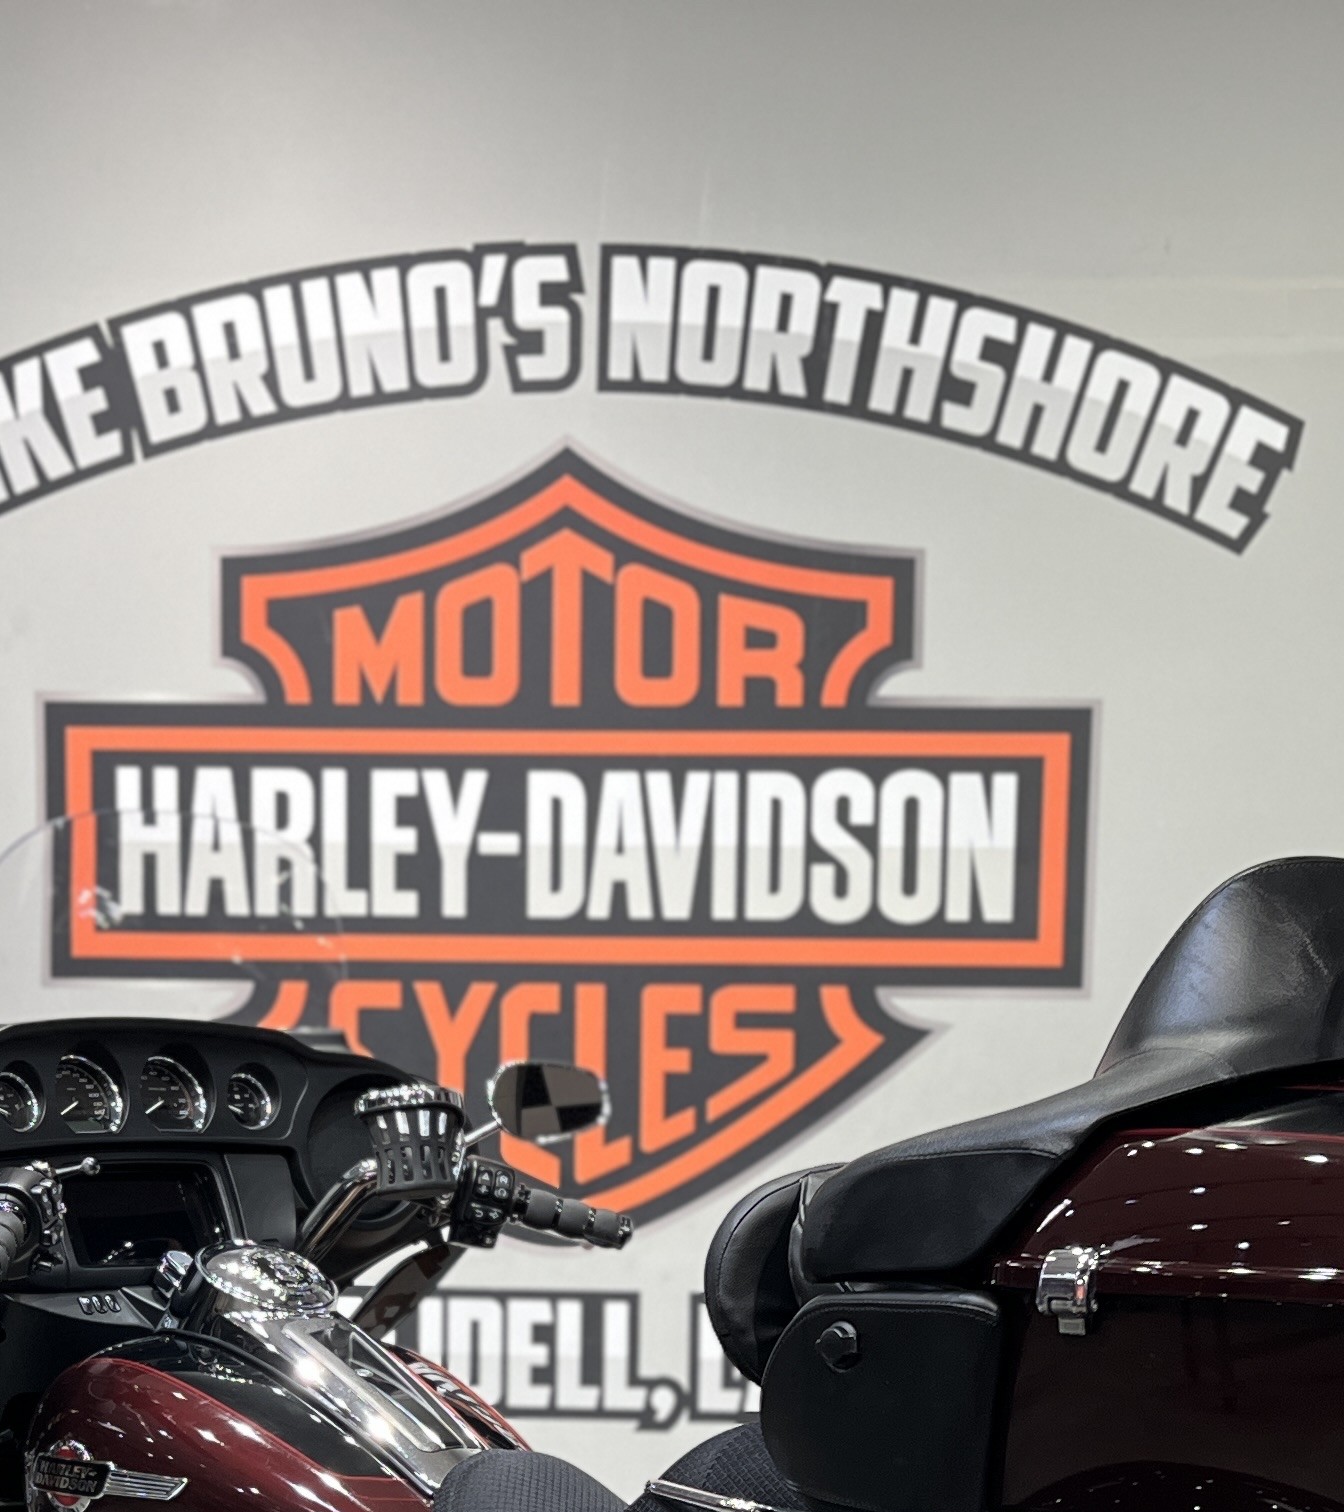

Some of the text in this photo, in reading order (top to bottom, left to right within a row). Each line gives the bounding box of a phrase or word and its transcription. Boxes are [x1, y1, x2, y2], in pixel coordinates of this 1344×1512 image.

[119, 252, 574, 447] BRUNO'S
[606, 253, 1292, 542] NORTHSHORE
[332, 526, 807, 707] MOTOR
[114, 764, 1019, 926] HARLEY-DAVIDSON
[336, 1296, 681, 1424] IDELL,
[34, 1459, 98, 1493] HARLEY- DAVIDSON
